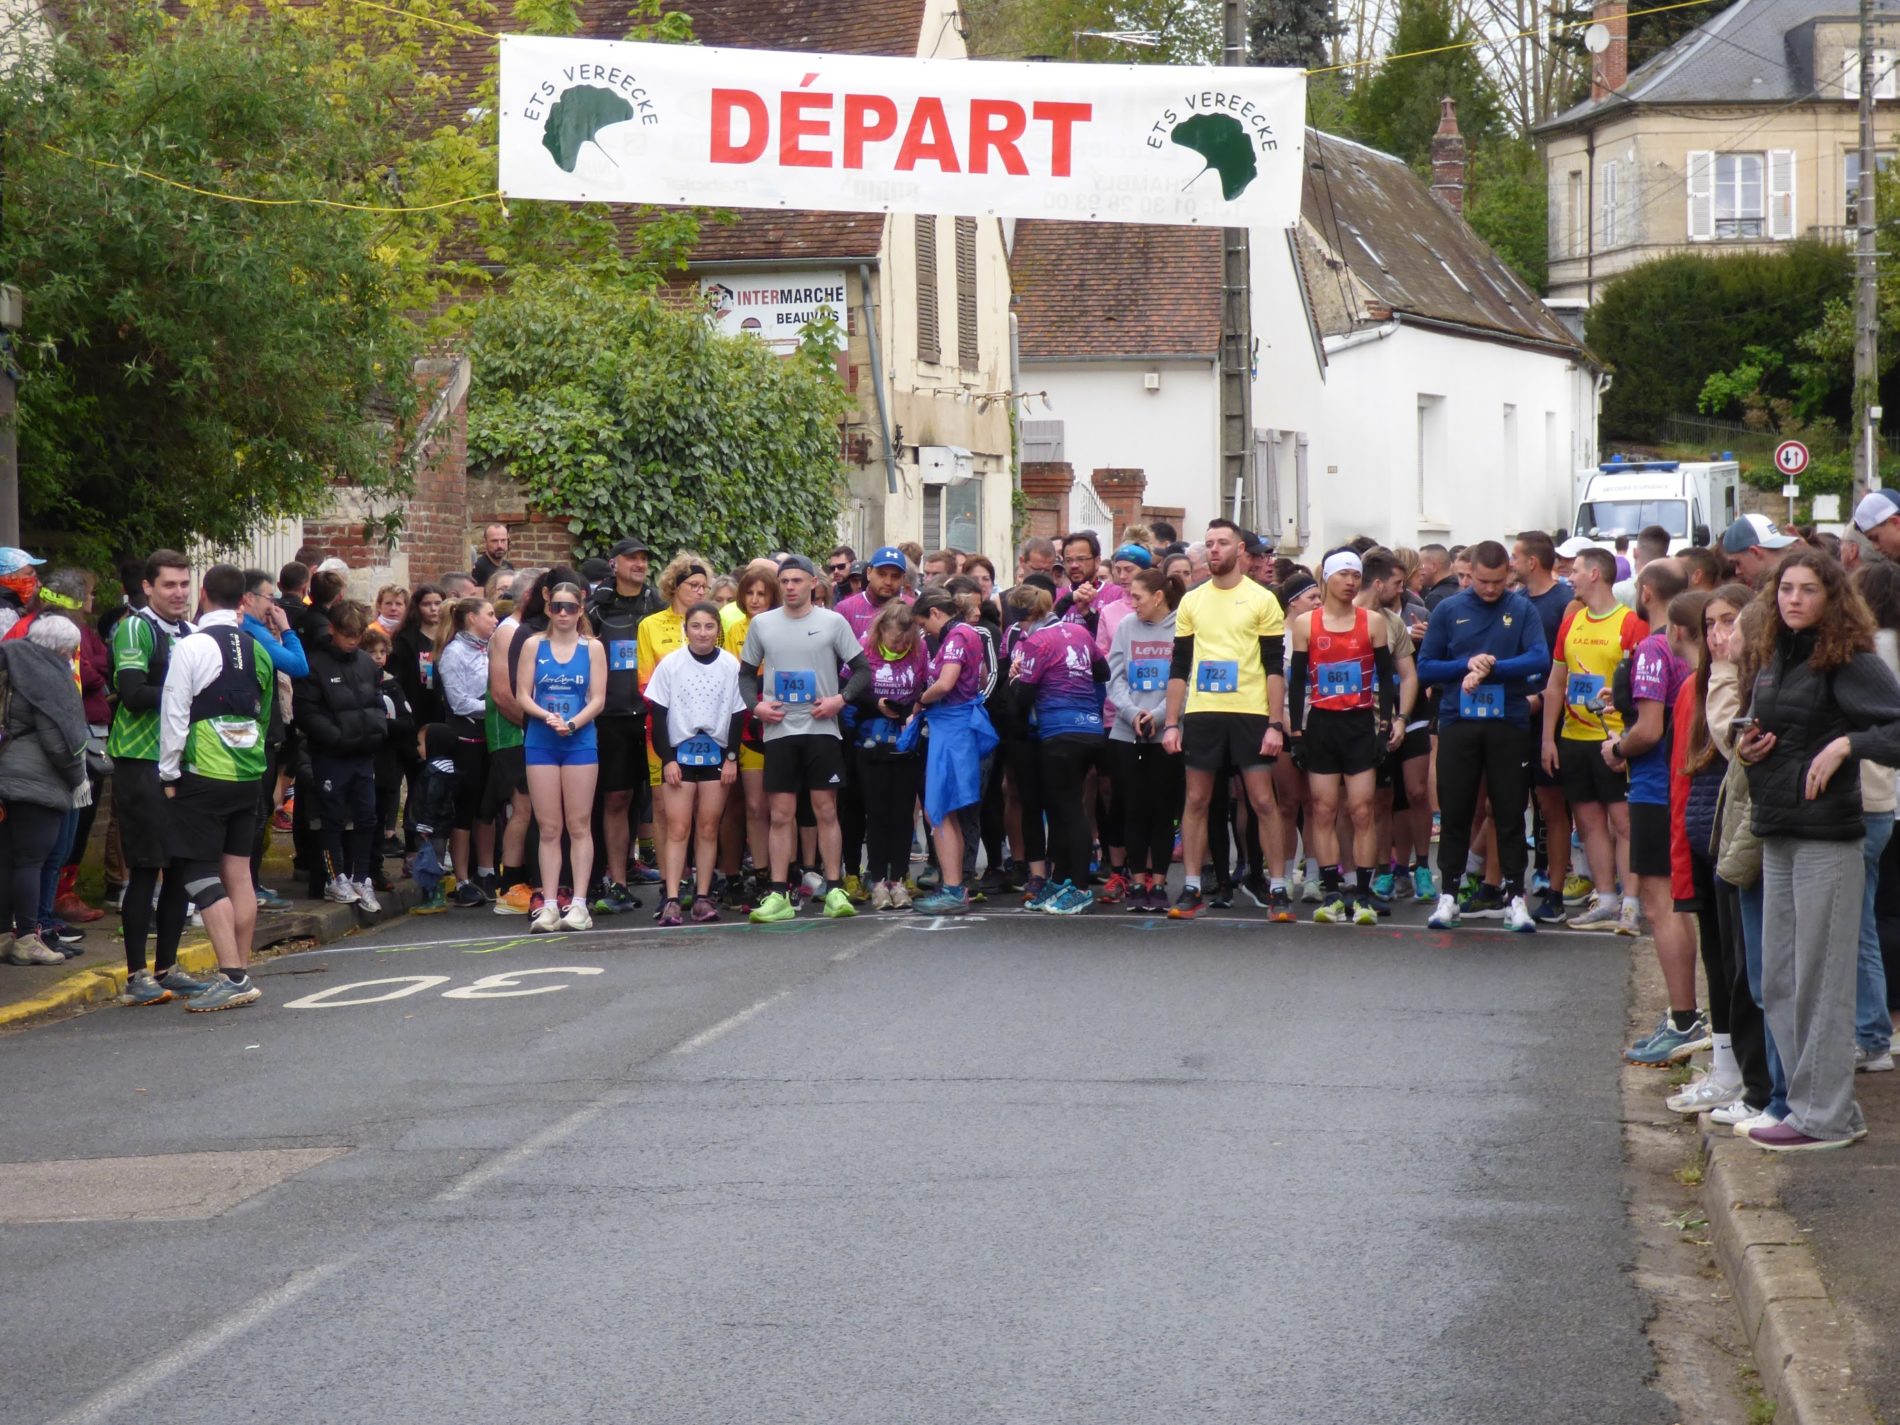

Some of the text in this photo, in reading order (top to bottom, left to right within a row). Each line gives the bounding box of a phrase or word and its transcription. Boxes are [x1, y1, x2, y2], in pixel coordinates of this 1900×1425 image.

[524, 63, 659, 127] ETS VEREECKE
[711, 72, 1093, 178] DÉPART
[1147, 91, 1278, 153] ETS VEREECKE
[737, 286, 844, 306] INTERMARCHE
[233, 633, 244, 670] SALOMON
[1137, 667, 1159, 679] 639
[1204, 668, 1227, 680] 722
[1328, 671, 1349, 683] 681
[783, 679, 804, 691] 743
[1573, 681, 1593, 693] 725
[1471, 693, 1494, 705] 746
[547, 702, 570, 714] 619
[688, 742, 710, 754] 723
